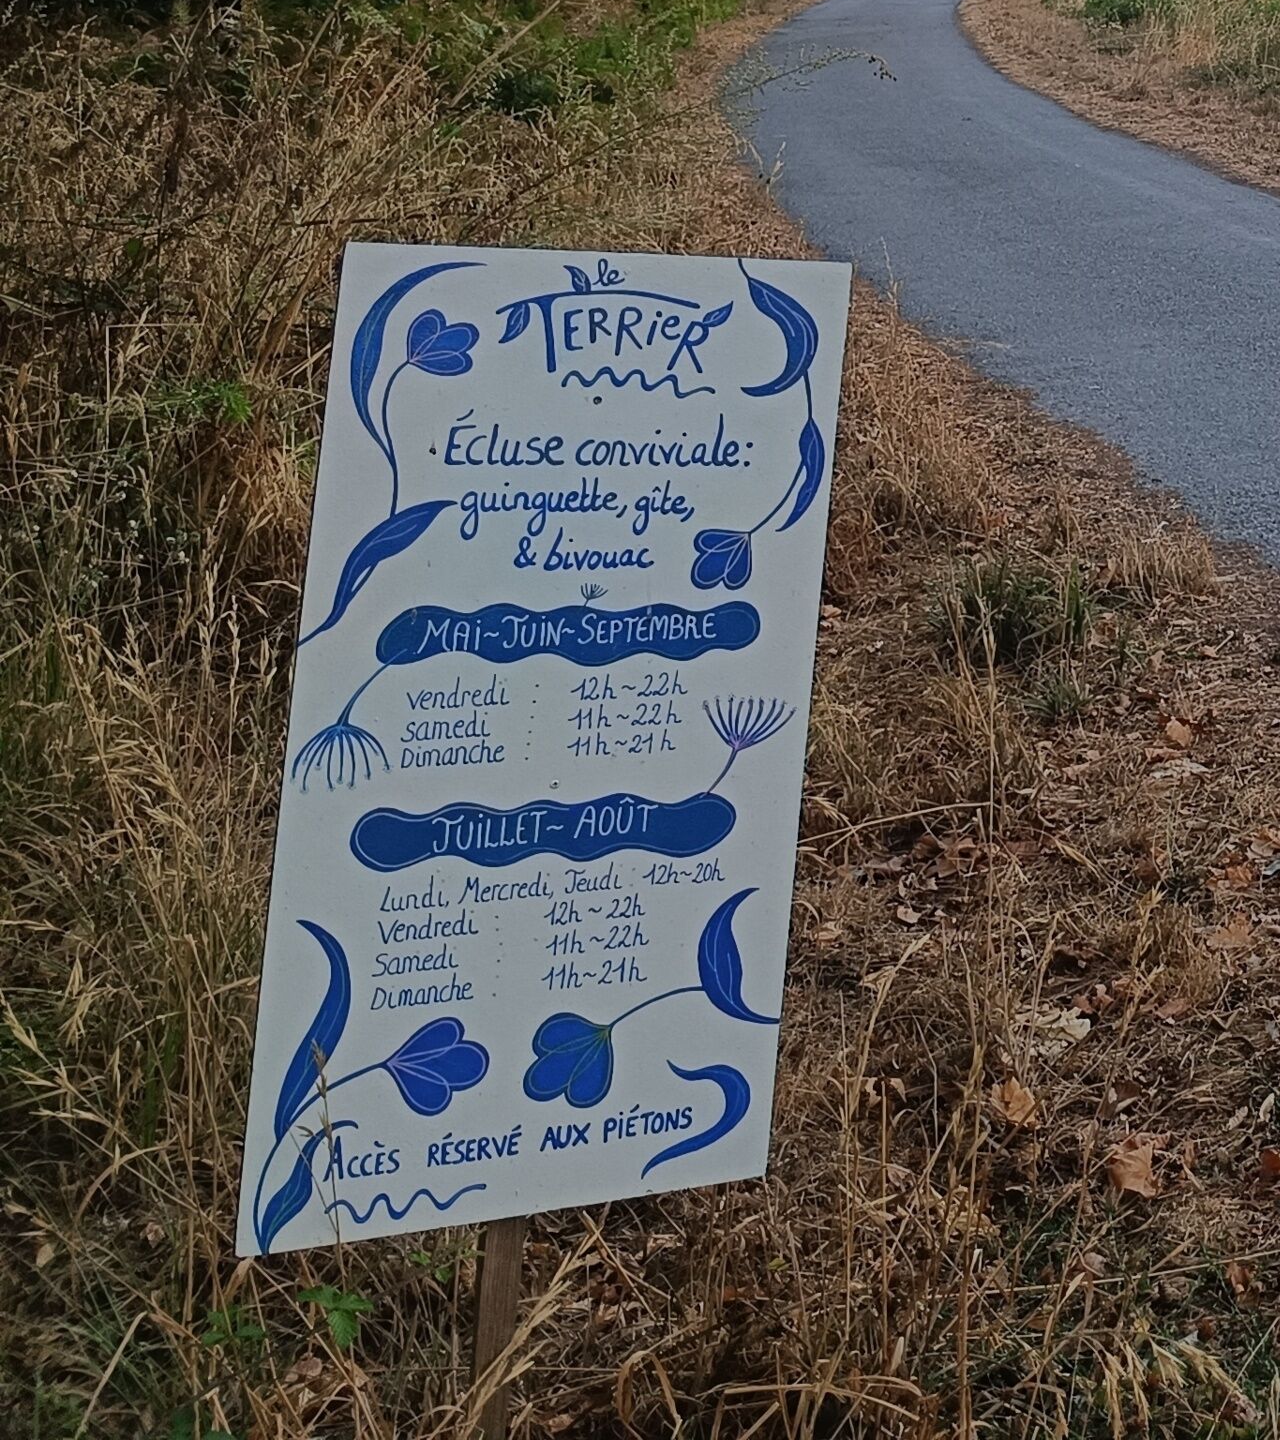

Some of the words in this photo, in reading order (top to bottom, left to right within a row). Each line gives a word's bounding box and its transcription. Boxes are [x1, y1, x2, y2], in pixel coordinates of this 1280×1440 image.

[592, 258, 626, 287] le
[444, 409, 565, 466] Écluse
[575, 413, 754, 467] conviviale:
[459, 477, 628, 541] guinguette,
[632, 479, 695, 536] gîte,
[513, 536, 538, 569] &
[543, 526, 655, 571] bivouac
[400, 739, 505, 769] Dimanche
[379, 874, 450, 912] Lundi,
[457, 870, 554, 905] Mercredi,
[564, 861, 623, 894] Jeudi
[377, 907, 480, 945] Vendredi
[371, 942, 460, 978] Samedi
[370, 972, 474, 1010] Dimanche
[426, 1123, 523, 1168] RÉSERVÉ
[539, 1122, 592, 1152] AUX
